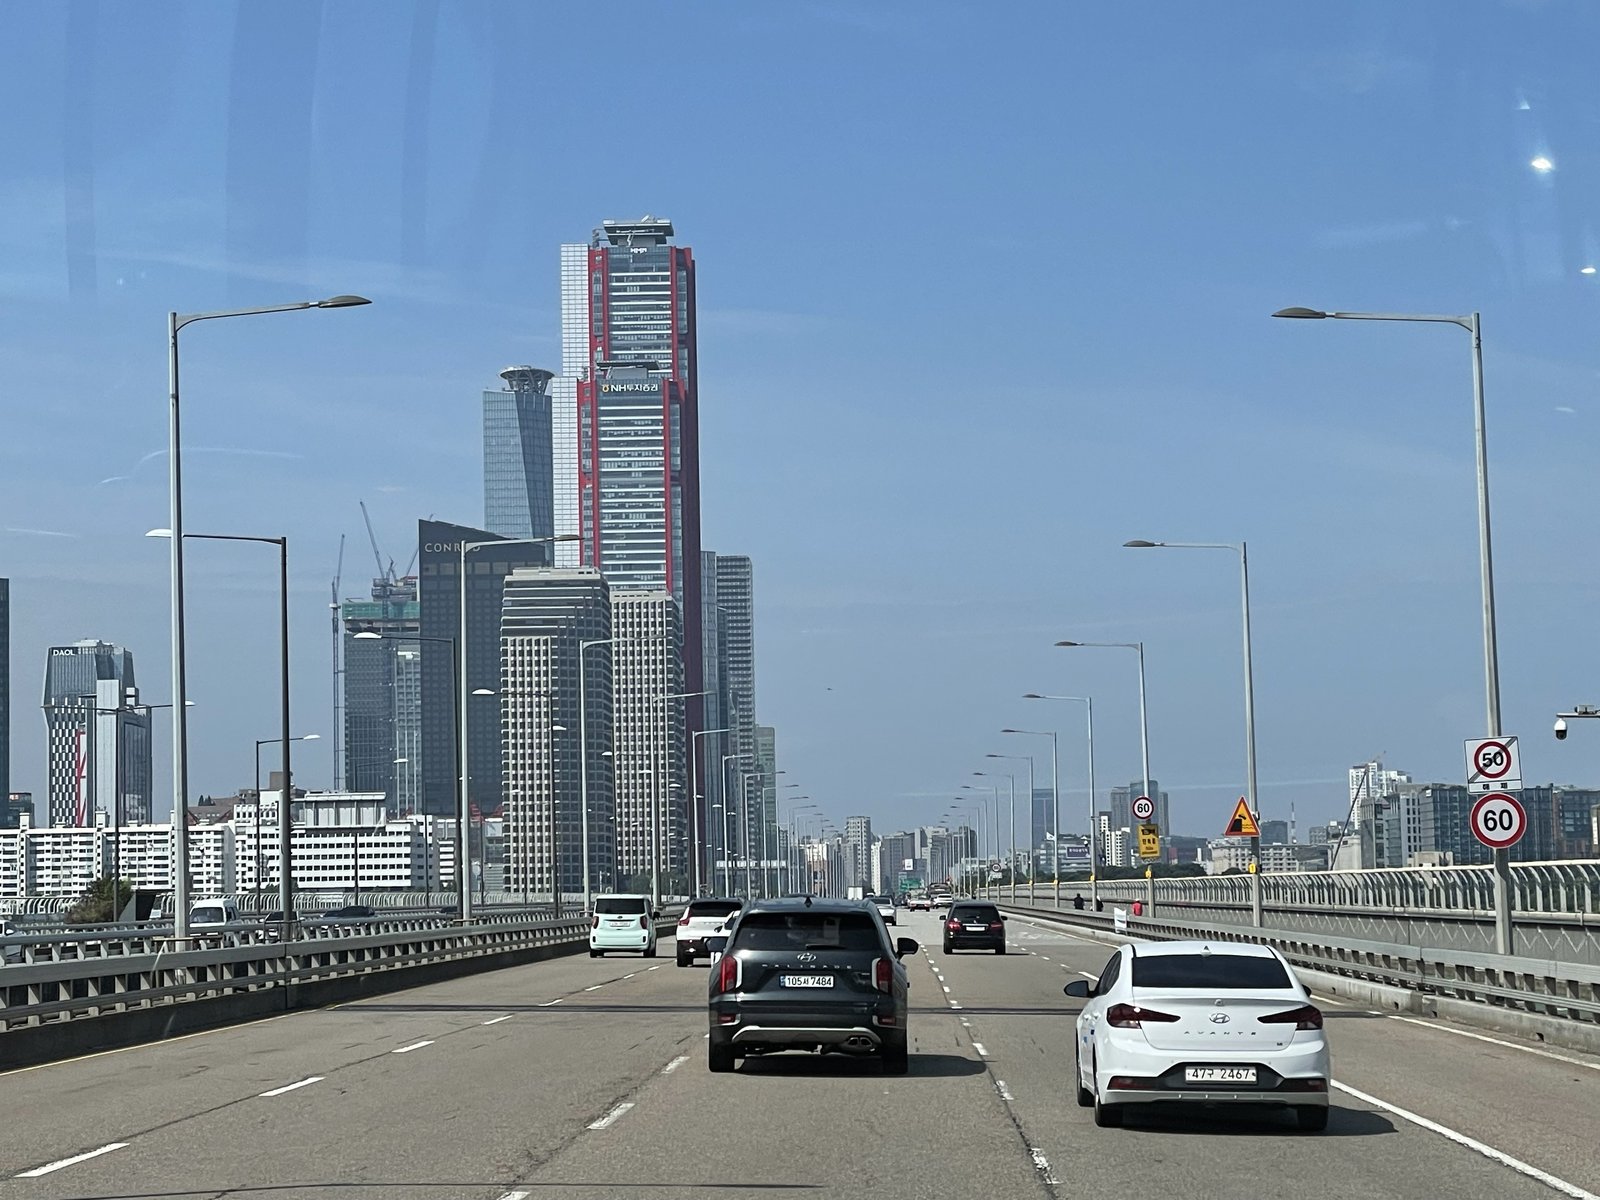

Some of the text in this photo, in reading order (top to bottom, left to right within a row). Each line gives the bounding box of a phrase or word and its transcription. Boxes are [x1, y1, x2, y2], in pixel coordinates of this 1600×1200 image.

[1482, 751, 1504, 768] 50
[1137, 803, 1150, 813] 60
[1483, 809, 1513, 832] 60
